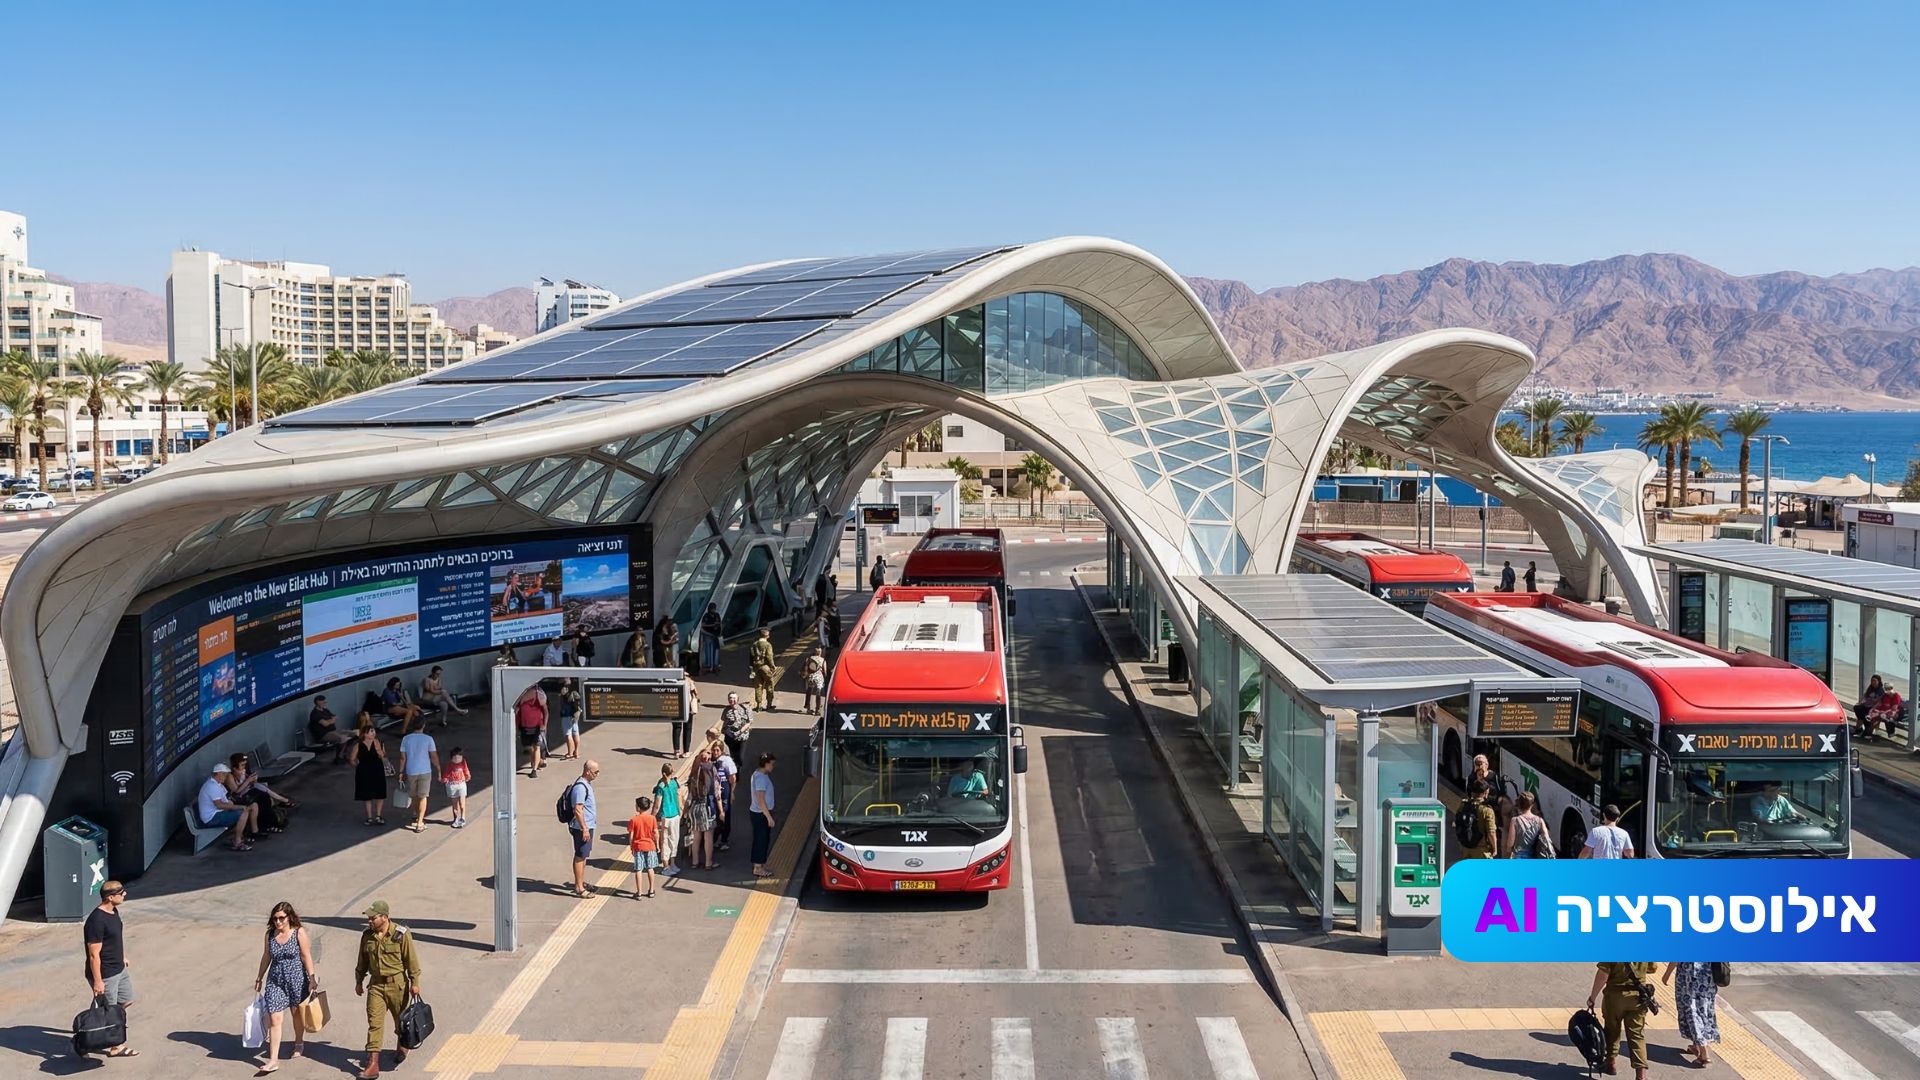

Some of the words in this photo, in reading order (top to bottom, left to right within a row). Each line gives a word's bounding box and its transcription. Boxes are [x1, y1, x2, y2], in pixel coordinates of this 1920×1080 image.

[447, 552, 478, 567] הבאים
[481, 549, 514, 562] ברוכים
[412, 556, 444, 572] לתחנה
[340, 566, 371, 583] באילת
[209, 593, 243, 616] Welcome
[244, 590, 253, 604] to
[253, 584, 267, 601] the
[268, 581, 288, 598] New
[289, 575, 309, 593] Eilat
[310, 571, 329, 588] Hub
[860, 711, 928, 728] אילת-מרכז
[957, 713, 971, 731] קו
[1697, 735, 1729, 749] טאבה
[1738, 735, 1778, 749] מרכזית
[1801, 735, 1813, 752] קו
[901, 830, 928, 843] אגד
[1406, 894, 1430, 907] אגד
